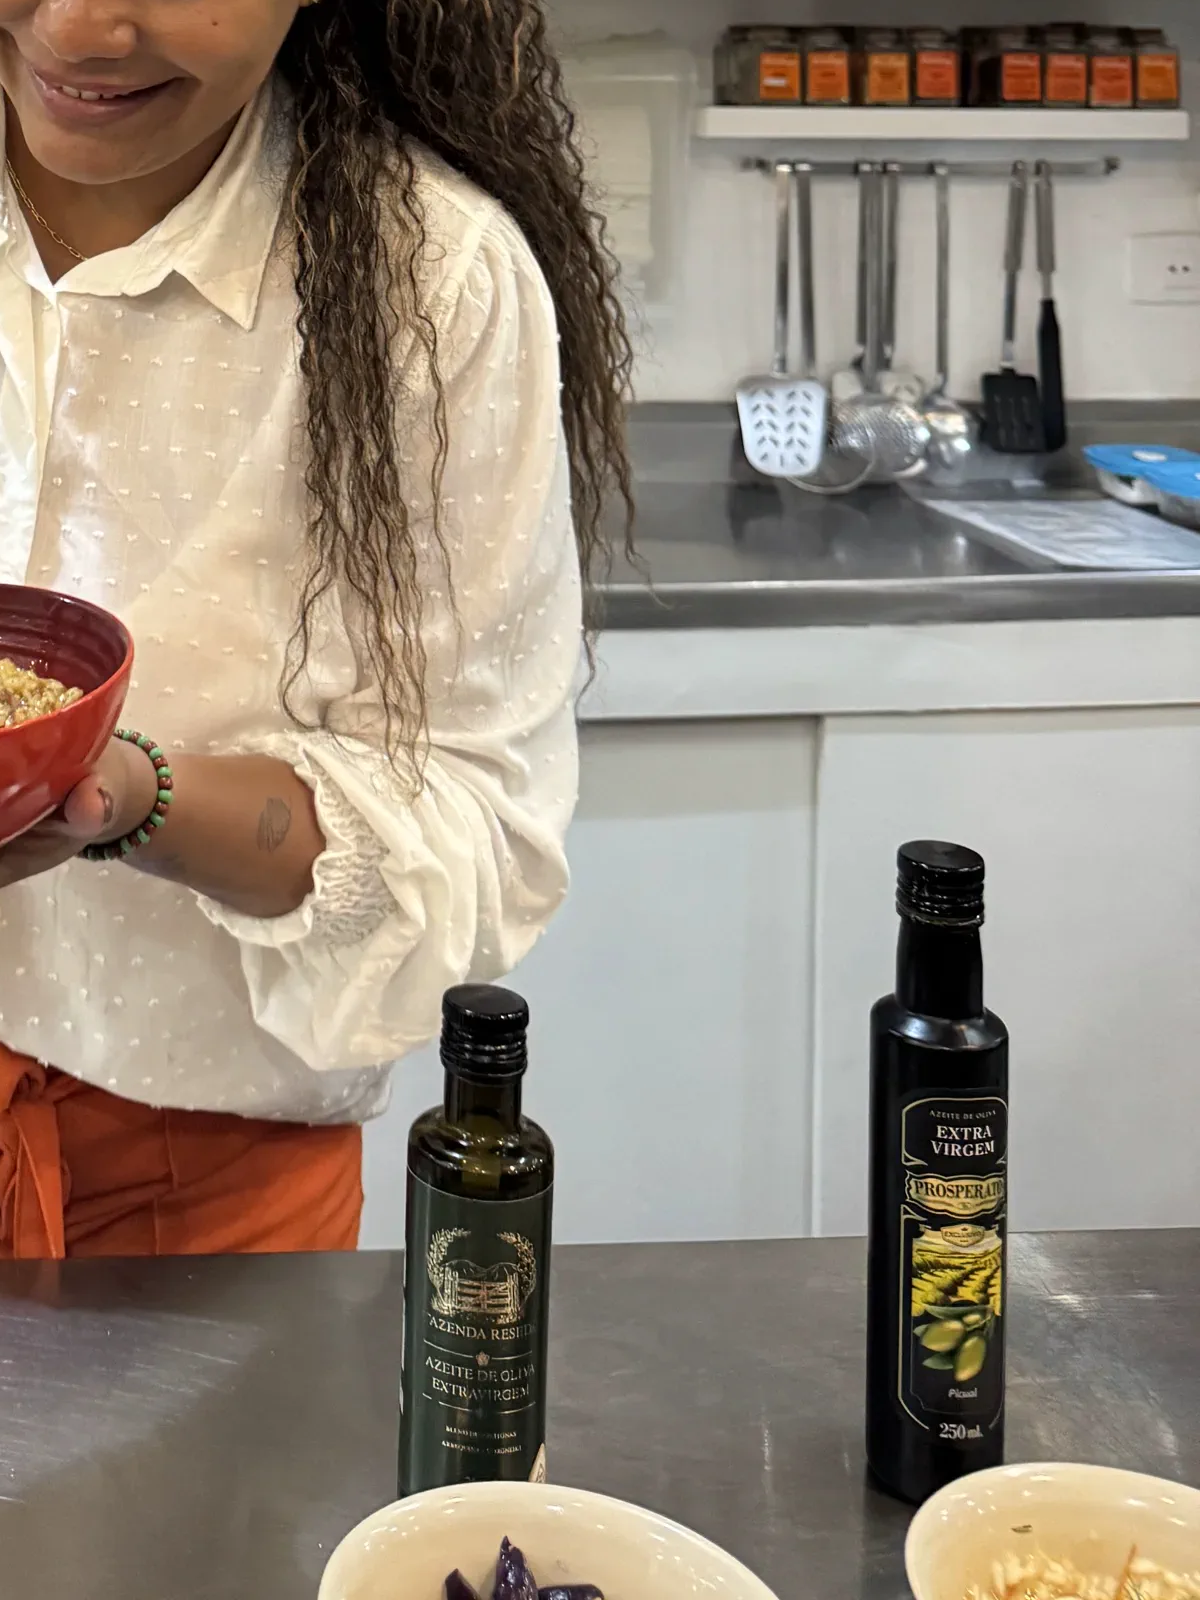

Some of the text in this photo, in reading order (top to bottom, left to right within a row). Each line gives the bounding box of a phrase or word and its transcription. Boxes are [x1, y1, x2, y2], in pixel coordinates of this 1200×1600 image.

[936, 1125, 992, 1141] EXTRA
[930, 1140, 996, 1157] VIRGEM
[425, 1355, 474, 1380] AZEITE
[477, 1369, 498, 1382] DE
[939, 1422, 966, 1440] 250
